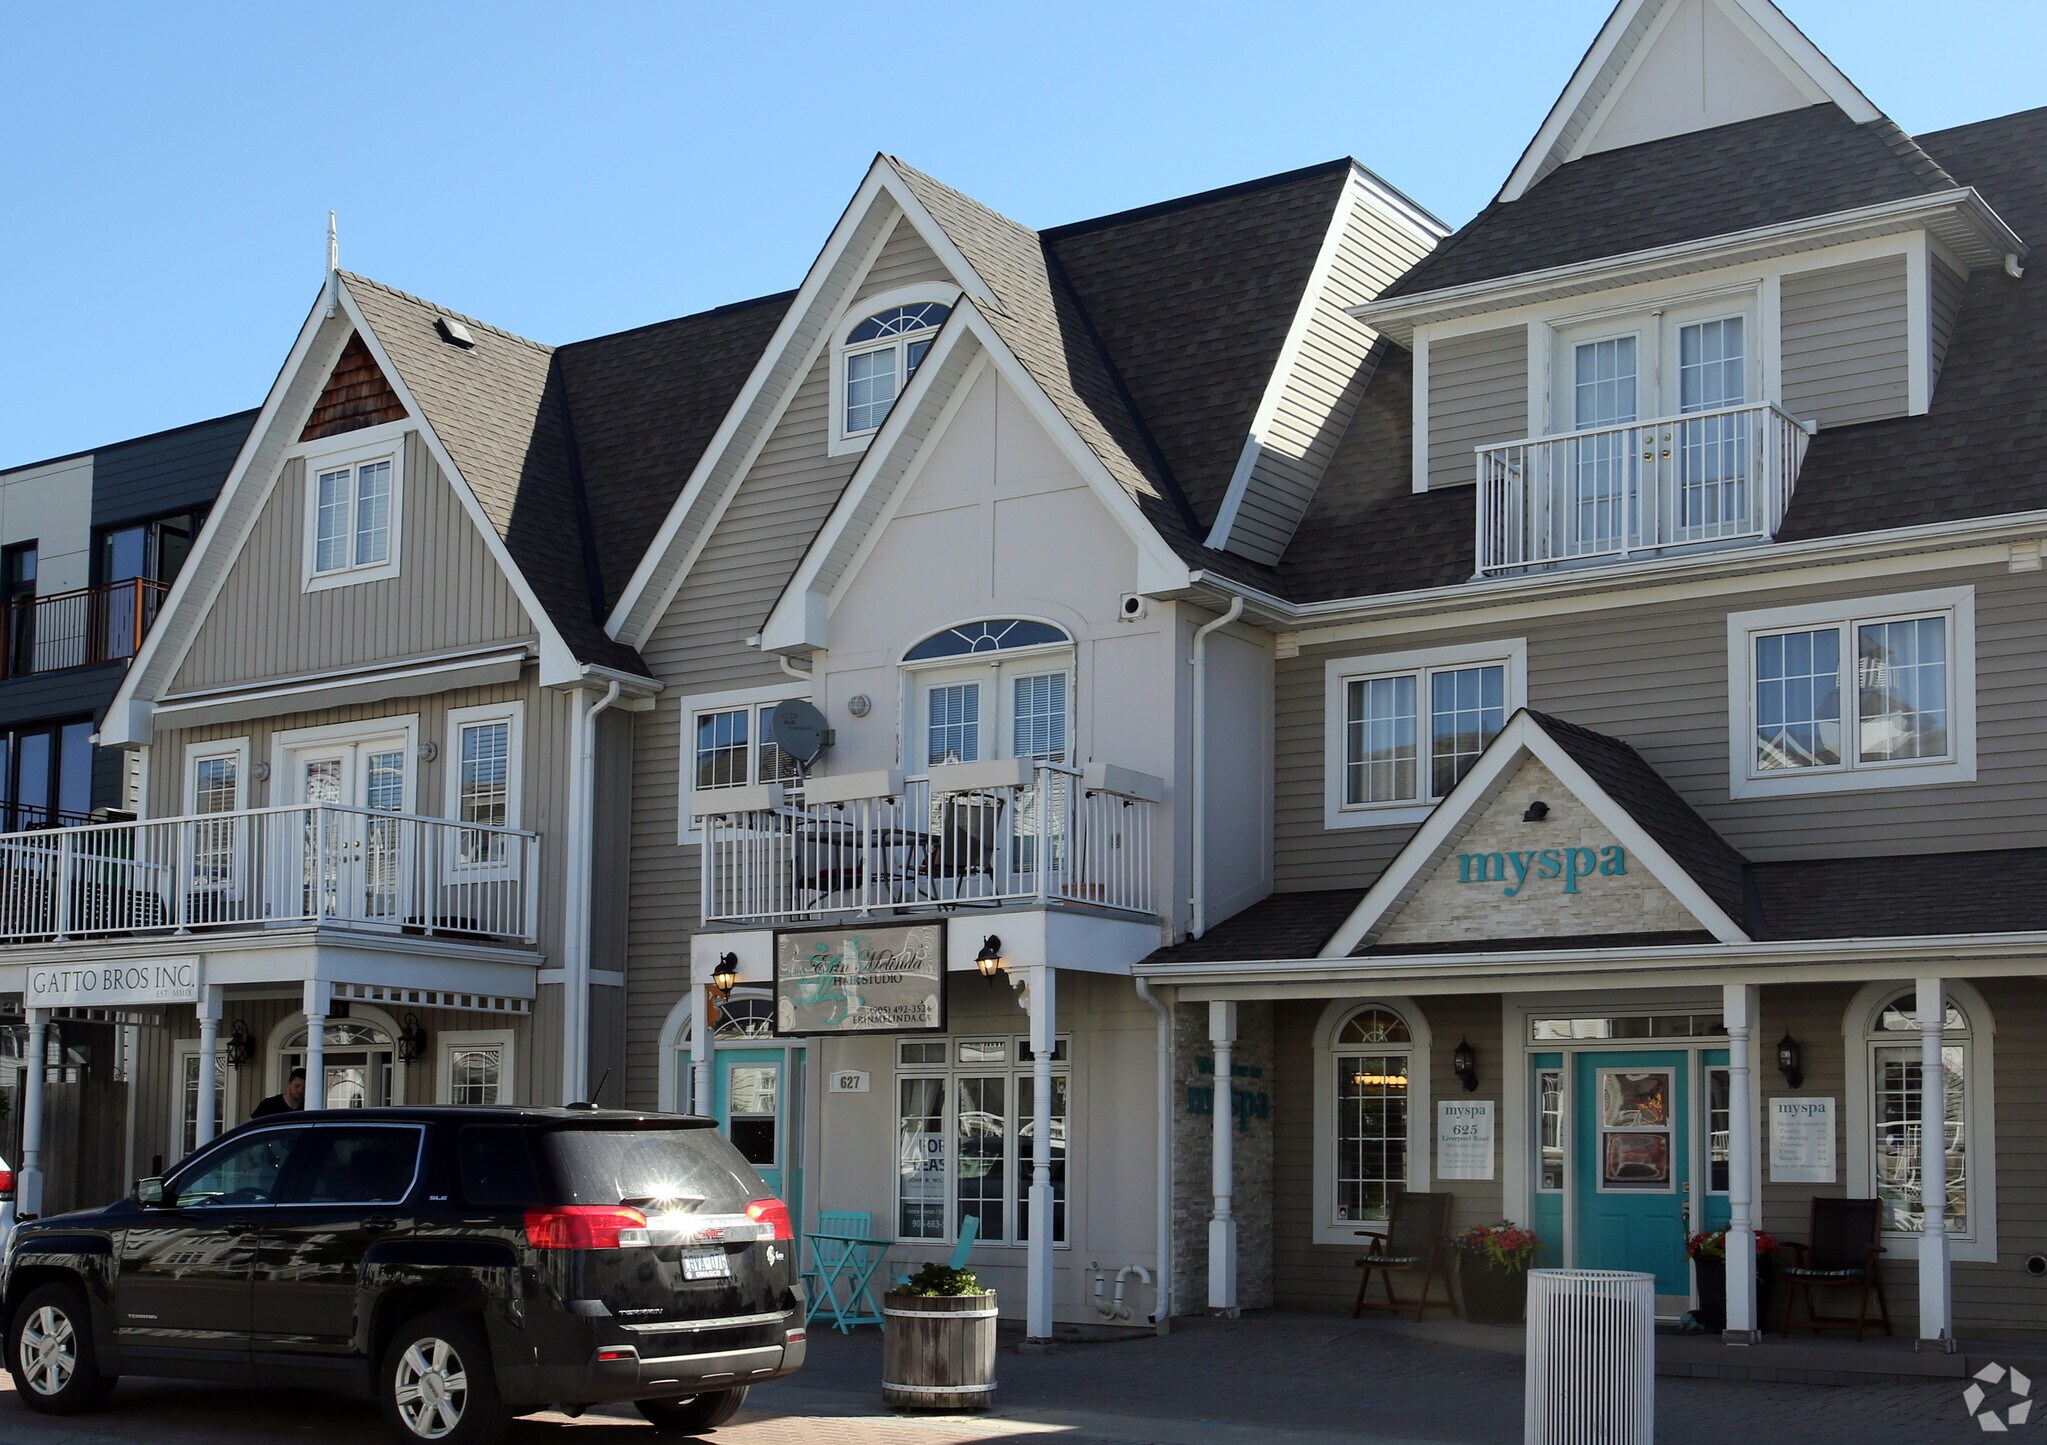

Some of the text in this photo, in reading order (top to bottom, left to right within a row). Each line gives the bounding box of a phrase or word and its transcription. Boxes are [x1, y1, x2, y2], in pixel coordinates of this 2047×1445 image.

[1456, 844, 1628, 897] myspa
[811, 950, 923, 974] Erin Melinda
[34, 965, 195, 993] GATTO BROS INC.
[833, 974, 903, 986] HAIR STUDIO
[156, 988, 193, 998] EST. MMIX
[869, 1004, 932, 1015] (905) 492-3524
[852, 1013, 932, 1025] ERINMELINDA.CA
[840, 1076, 860, 1089] 627
[1187, 1086, 1270, 1133] mspa
[1445, 1106, 1486, 1119] myspa
[1778, 1103, 1826, 1117] myspa
[1453, 1124, 1478, 1135] 625
[1442, 1135, 1472, 1143] Liverpool
[913, 1158, 944, 1171] LEAS
[694, 1228, 724, 1240] GMC
